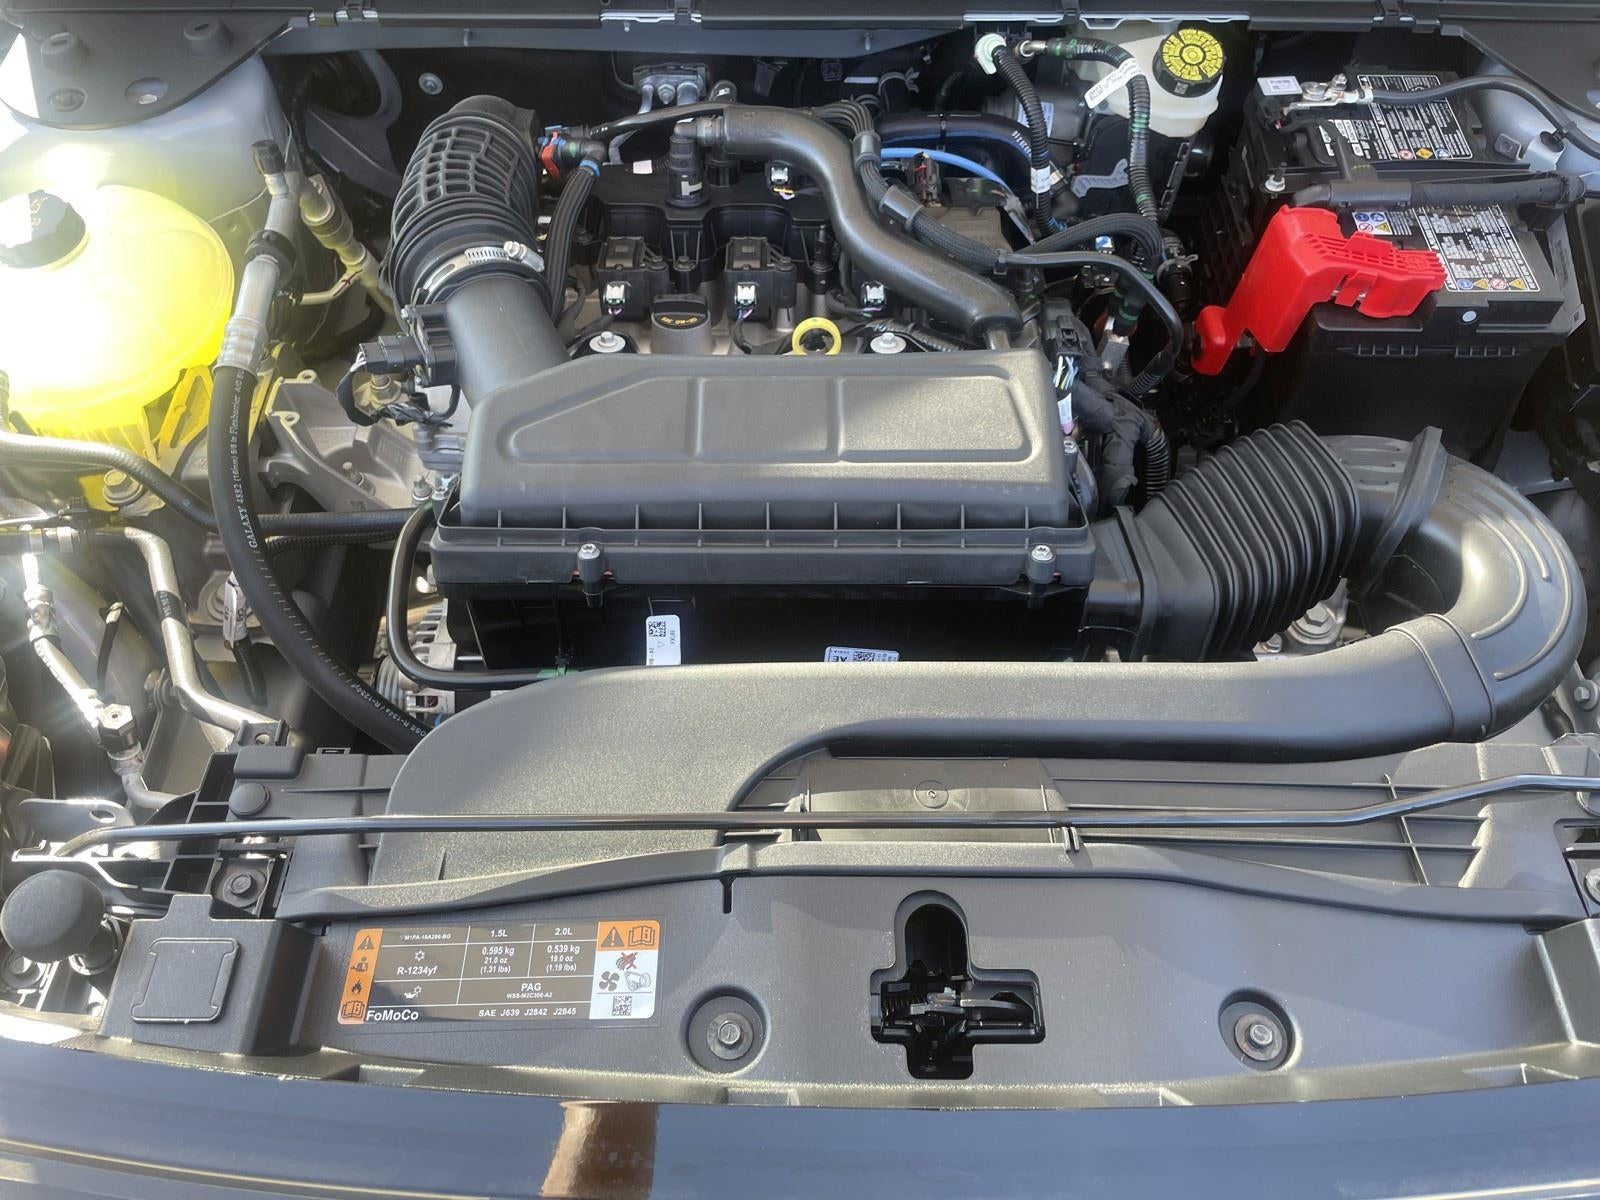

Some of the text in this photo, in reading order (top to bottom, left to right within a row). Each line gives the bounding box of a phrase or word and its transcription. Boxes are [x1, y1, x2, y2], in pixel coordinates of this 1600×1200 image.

[238, 505, 258, 549] GALAXY
[409, 724, 427, 737] OSE
[490, 929, 508, 938] 1.5L
[555, 928, 573, 936] 2.0L
[482, 946, 515, 956] 0.595 kg
[547, 945, 580, 954] 0.539 kg
[397, 966, 438, 976] R-1234yf
[480, 965, 511, 974] (1.31 lbs)
[546, 963, 577, 973] (1.19 lbs)
[521, 983, 542, 992] PAG
[366, 1009, 419, 1021] FoMoCo
[478, 1008, 577, 1017] SAE J639 J2842 J2845
